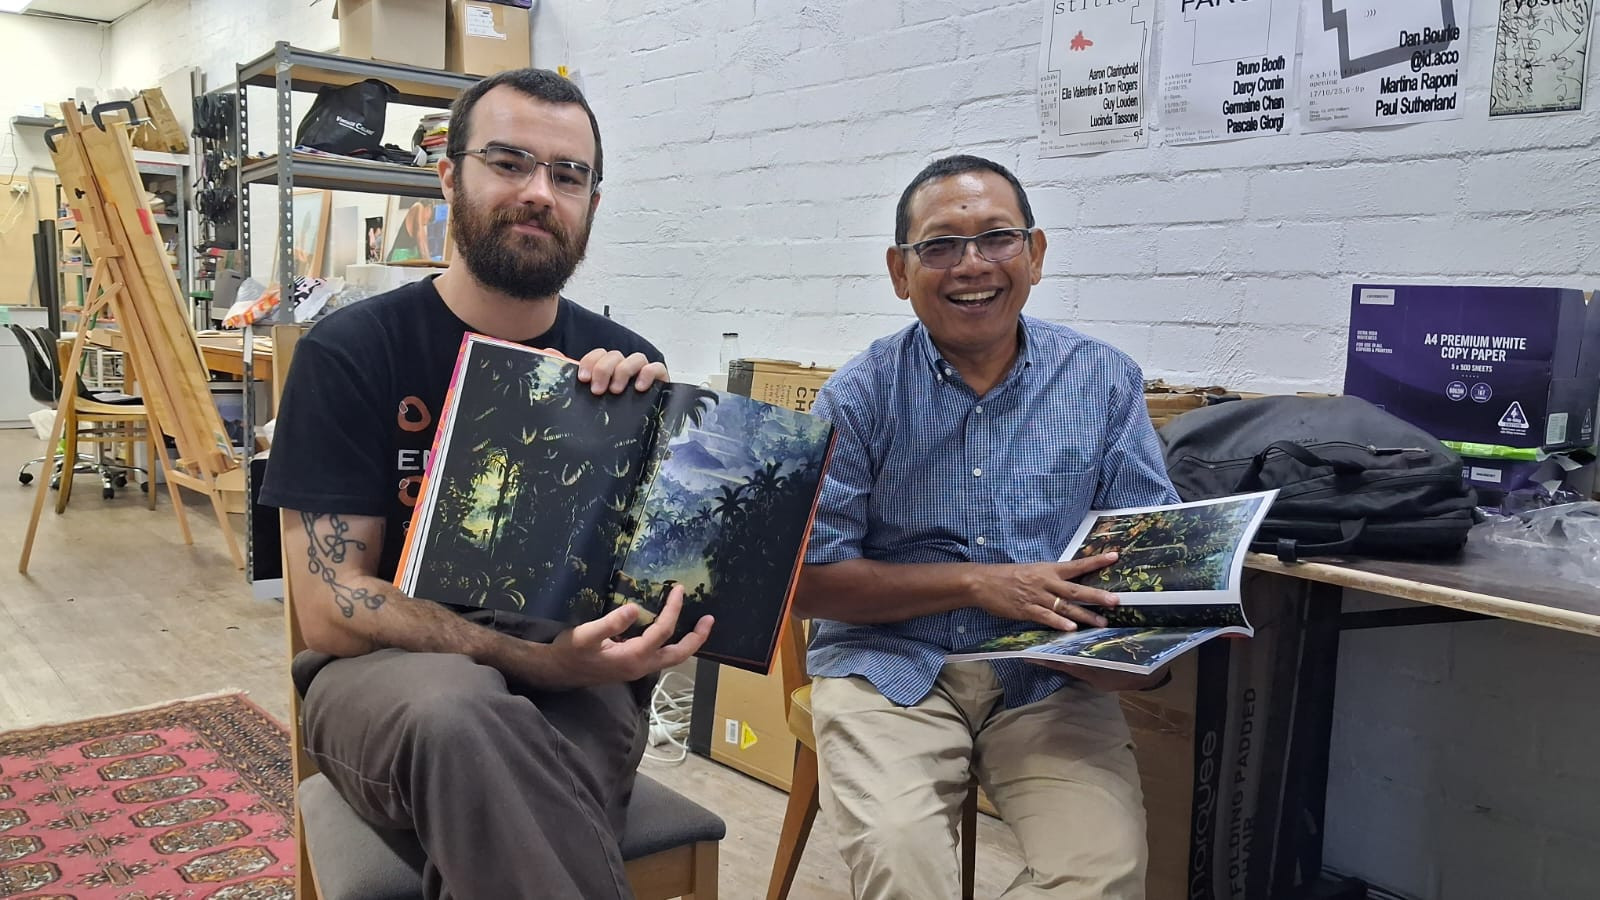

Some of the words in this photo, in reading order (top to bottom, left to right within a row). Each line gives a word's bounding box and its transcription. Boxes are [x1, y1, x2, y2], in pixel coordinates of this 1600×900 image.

[1400, 30, 1420, 48] Dan
[1423, 24, 1460, 45] Bourke
[1089, 68, 1106, 80] Aaron
[1106, 61, 1139, 79] Claringbold
[1236, 61, 1260, 76] Bruno
[1261, 55, 1286, 73] Booth
[1410, 49, 1459, 73] @id.acco
[1061, 87, 1072, 100] Ella
[1072, 84, 1098, 99] Valentine
[1098, 82, 1103, 95] &
[1104, 81, 1117, 94] Tom
[1117, 79, 1138, 94] Rogers
[1233, 80, 1257, 97] Darcy
[1257, 74, 1285, 92] Cronin
[1380, 75, 1418, 95] Martina
[1421, 68, 1459, 93] Raponi
[1102, 96, 1115, 112] Guy
[1116, 95, 1138, 109] Louden
[1222, 97, 1261, 116] Germaine
[1262, 95, 1285, 111] Chan
[1375, 98, 1399, 117] Paul
[1400, 92, 1457, 114] Sutherland
[1090, 113, 1113, 128] Lucinda
[1113, 111, 1139, 126] Tassone
[1226, 116, 1259, 135] Pascale
[1260, 113, 1285, 133] Giorgi
[1424, 333, 1438, 346] A4
[1440, 334, 1490, 348] PREMIUM
[1492, 336, 1527, 350] WHITE
[1441, 346, 1469, 360] COPY
[1471, 348, 1506, 362] PAPER
[1471, 364, 1493, 373] SHEETS
[1233, 687, 1257, 784] PADDED
[1227, 790, 1246, 897] FOLDING
